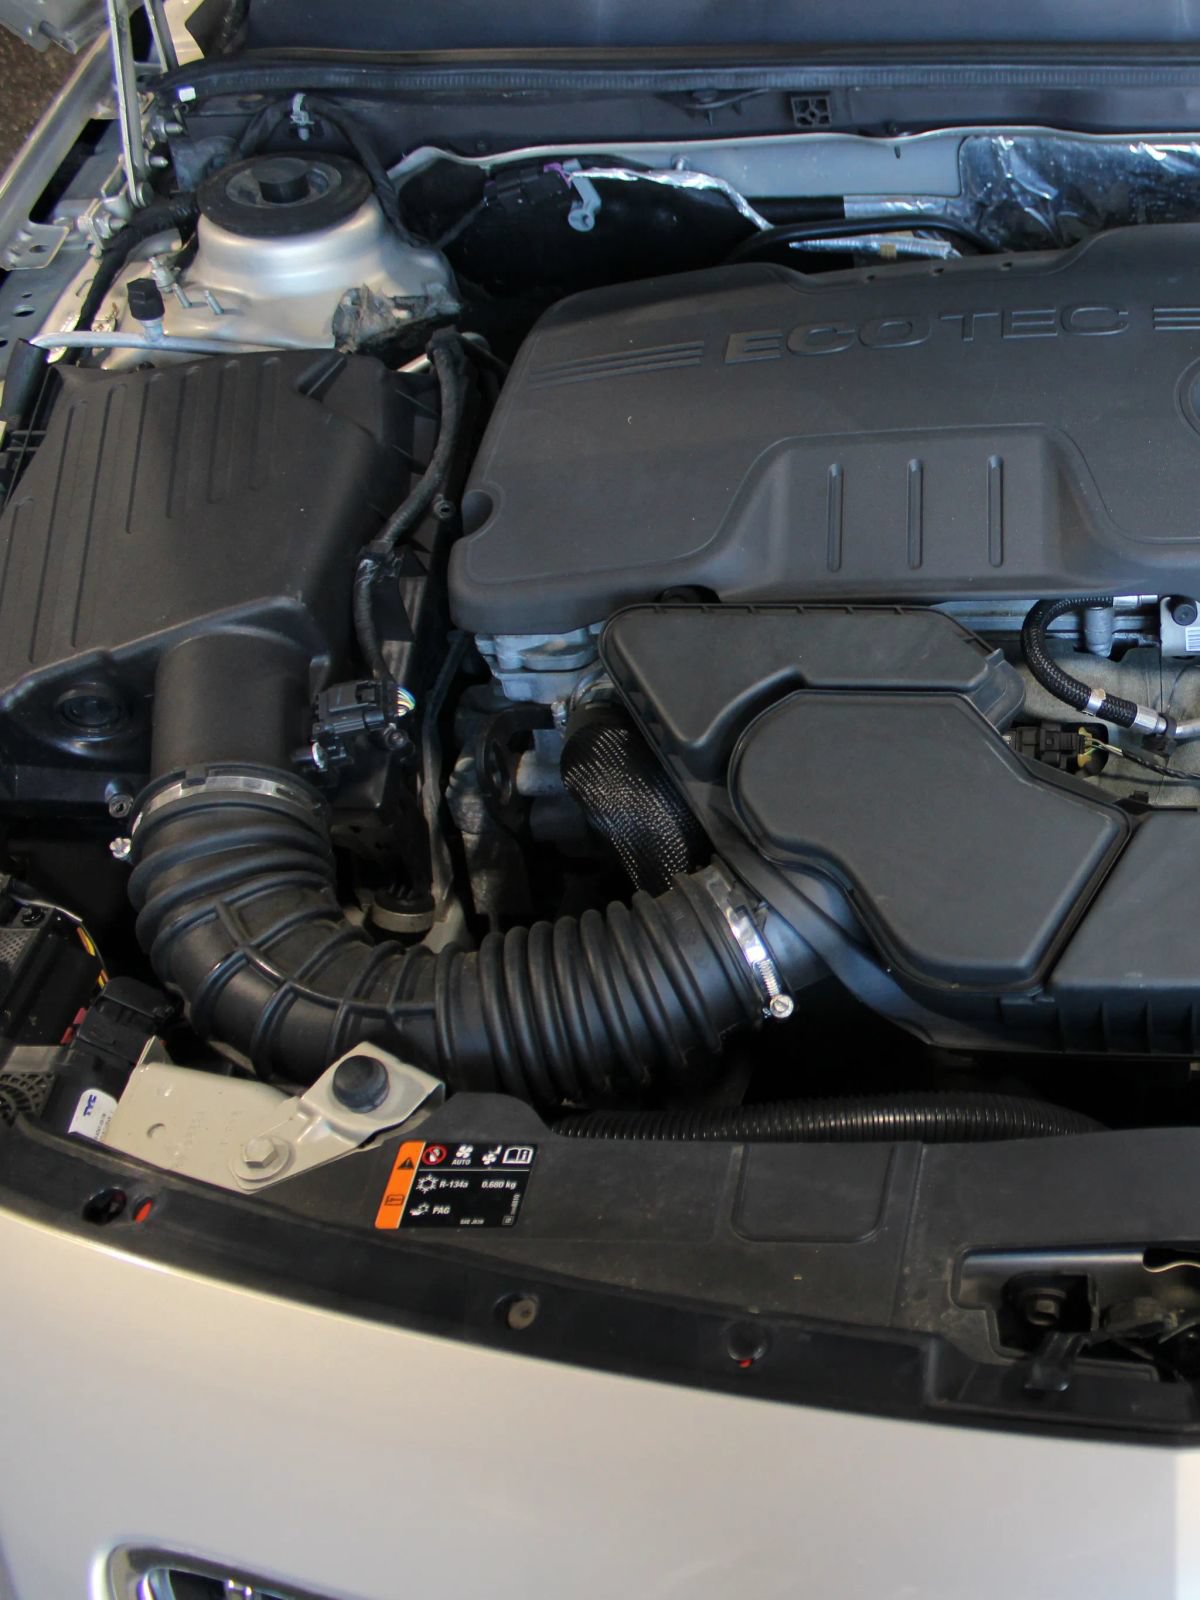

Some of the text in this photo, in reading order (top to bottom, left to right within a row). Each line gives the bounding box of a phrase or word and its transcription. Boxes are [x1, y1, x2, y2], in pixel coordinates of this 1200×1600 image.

[723, 304, 1130, 364] ECOTEC
[439, 1181, 517, 1190] R-134a 0.680 kg
[432, 1206, 450, 1215] PAG
